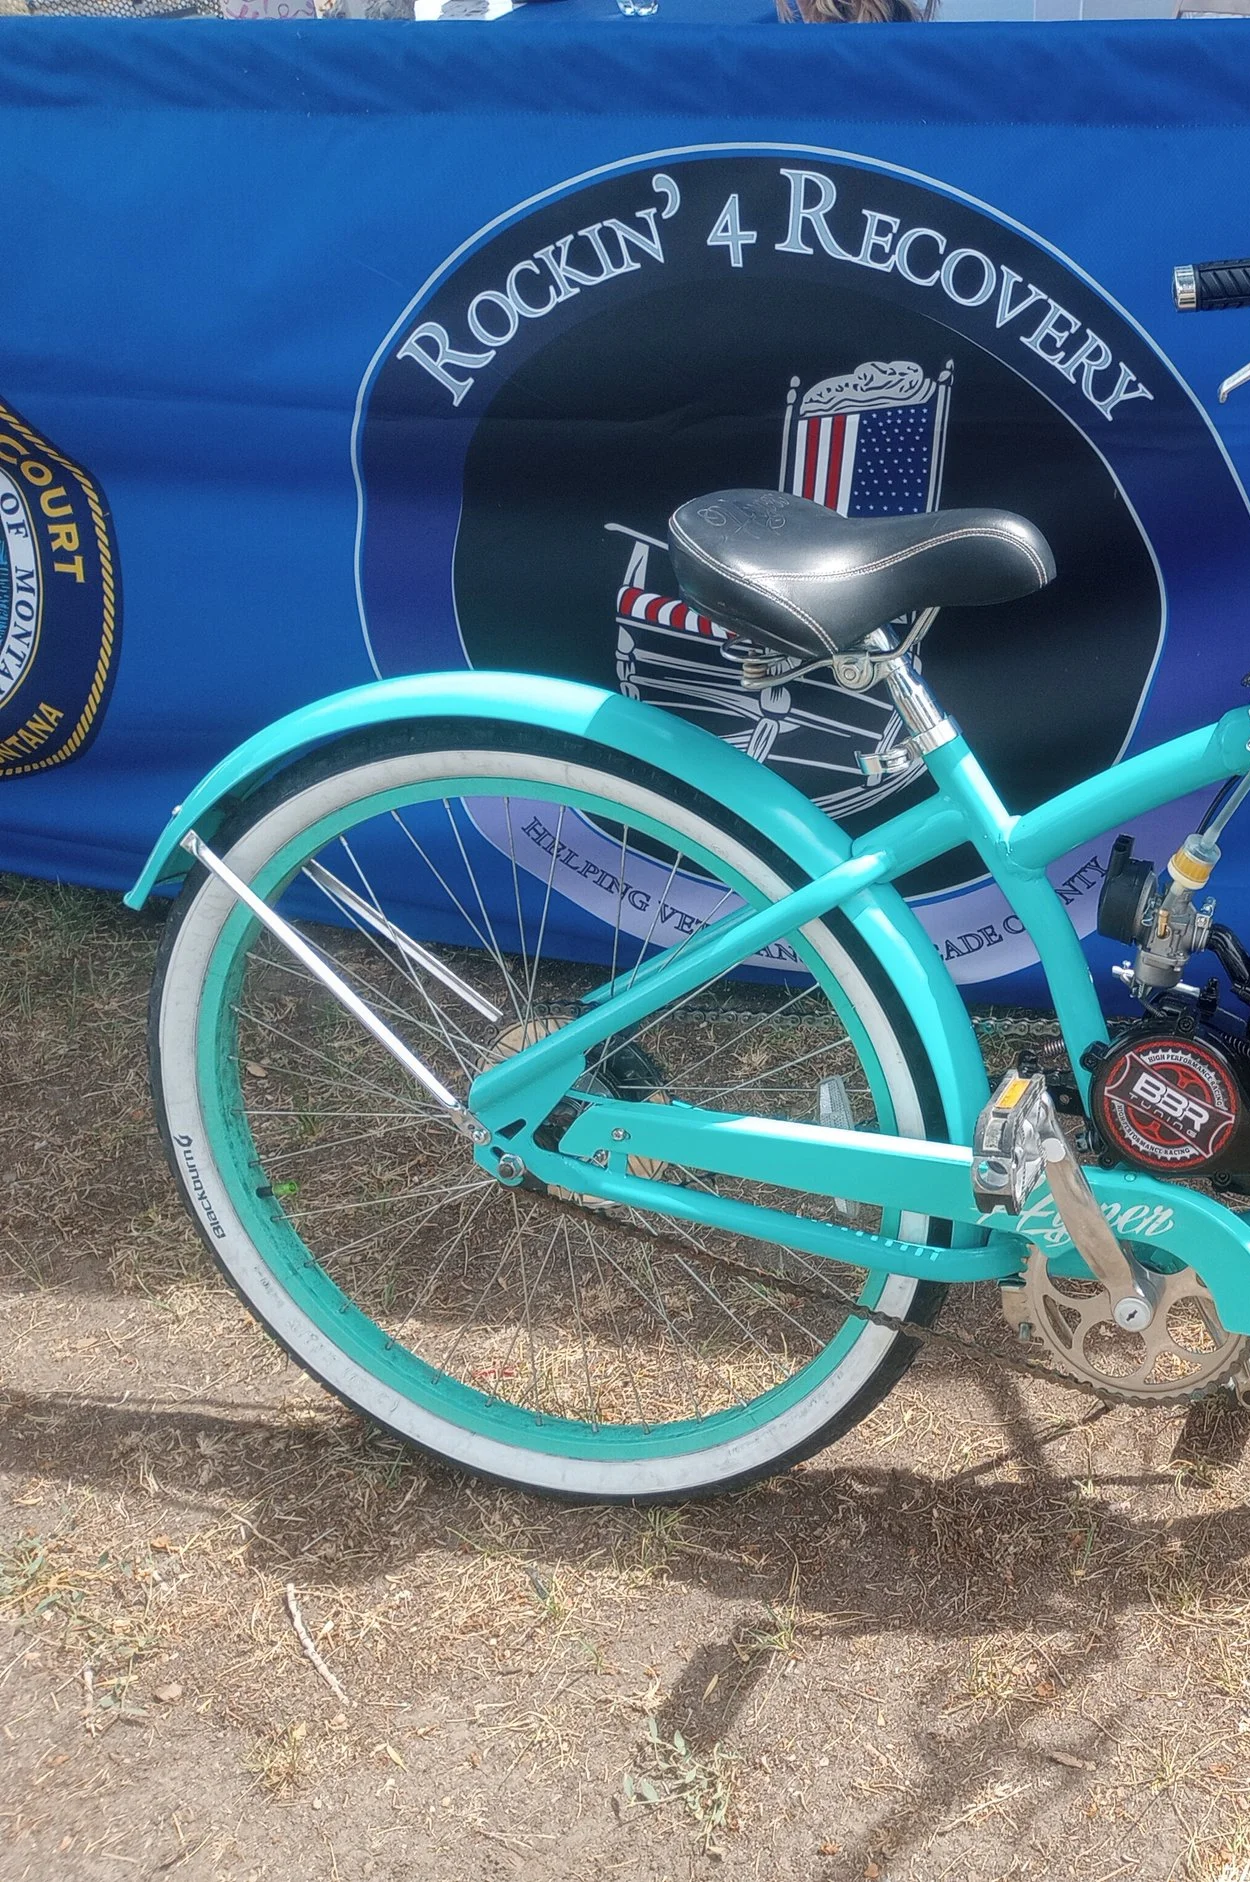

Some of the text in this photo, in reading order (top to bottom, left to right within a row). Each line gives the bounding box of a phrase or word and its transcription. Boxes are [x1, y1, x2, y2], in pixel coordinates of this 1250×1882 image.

[397, 168, 1154, 421] ROCKIN' 4 RECOVERY
[1, 492, 28, 541] OF
[0, 702, 64, 763] NTANA
[521, 816, 651, 912] HELPING
[1166, 1054, 1212, 1082] PERFORMANCE
[1133, 1072, 1209, 1132] BBR
